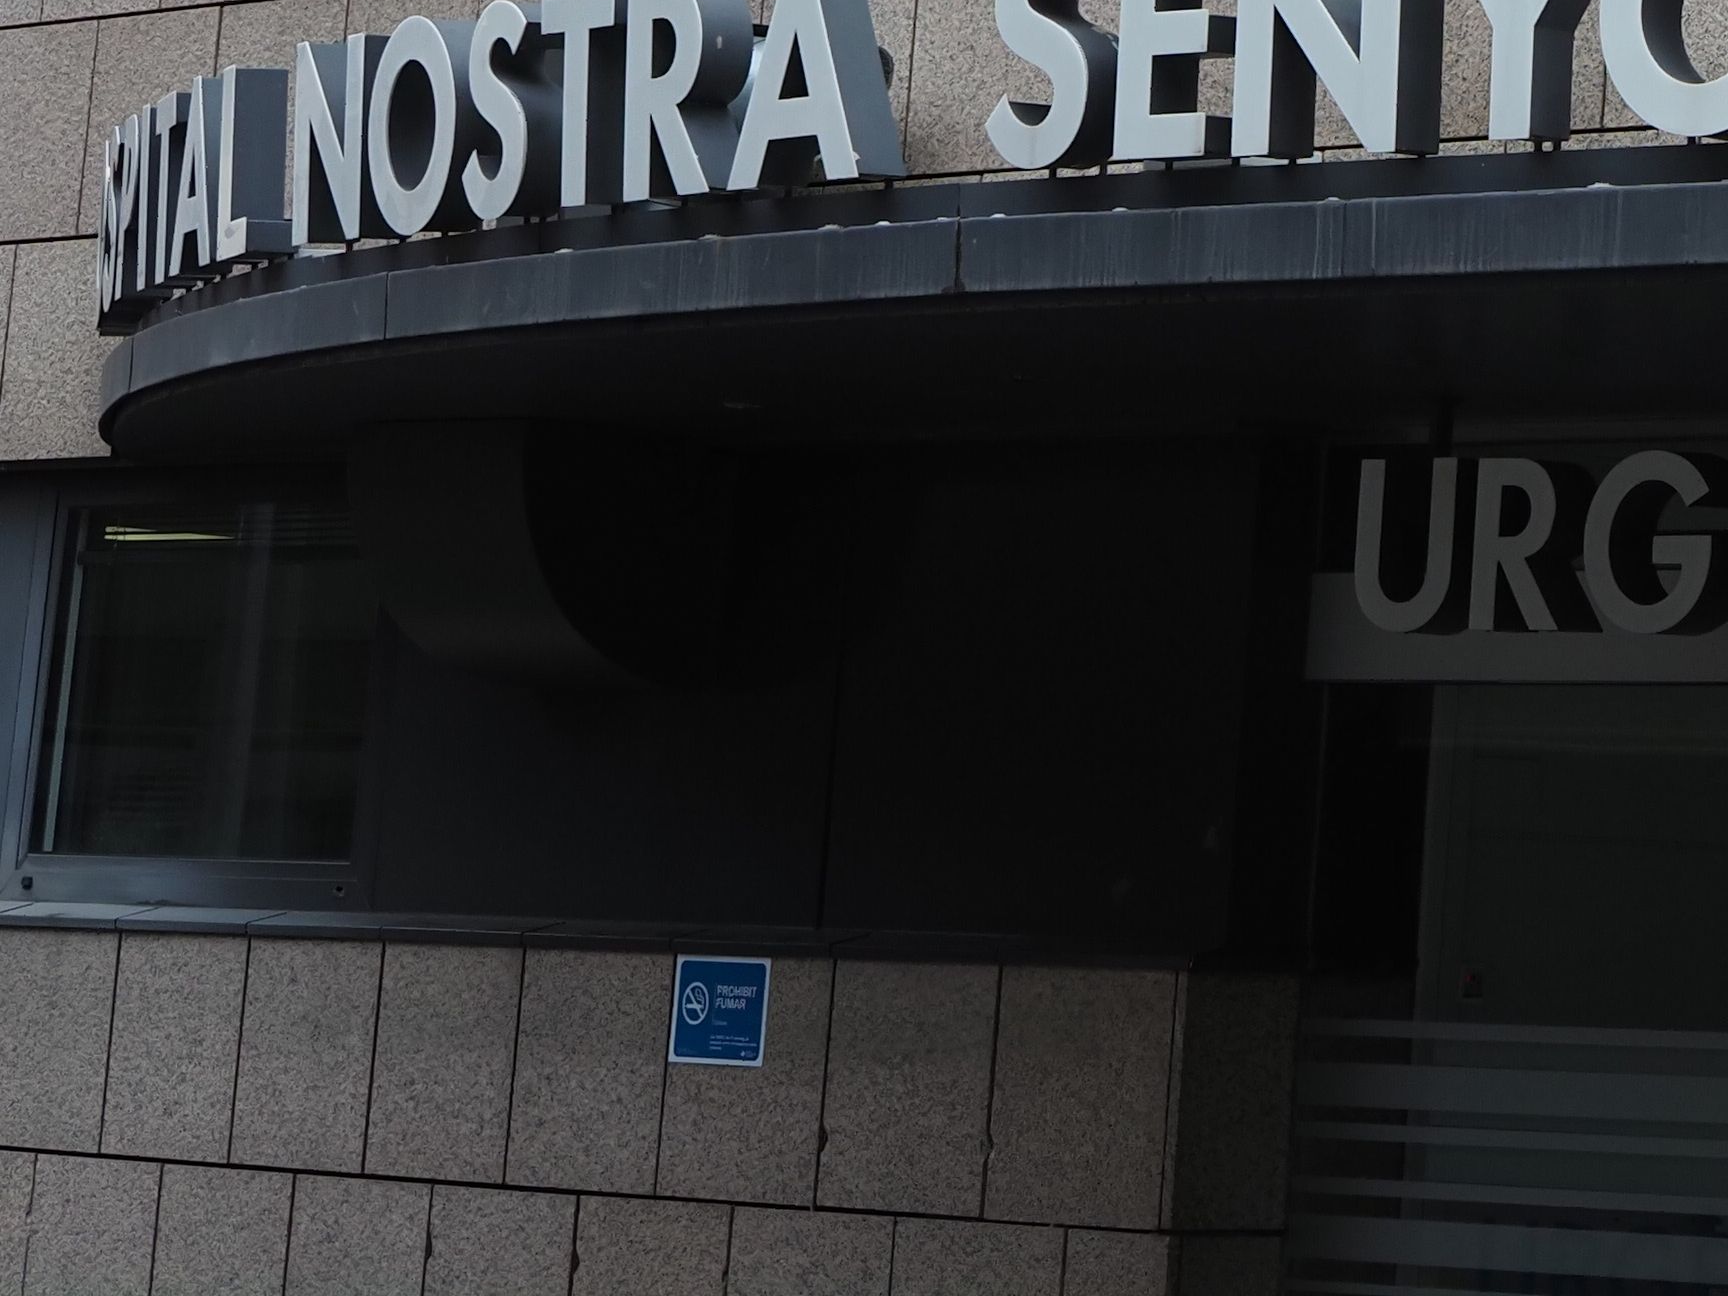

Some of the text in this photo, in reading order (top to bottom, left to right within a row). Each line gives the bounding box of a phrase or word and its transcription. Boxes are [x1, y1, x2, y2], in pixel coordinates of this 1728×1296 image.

[97, 63, 250, 315] SPITAL
[716, 984, 758, 999] PROHIBIT
[714, 997, 747, 1011] FUMAR
